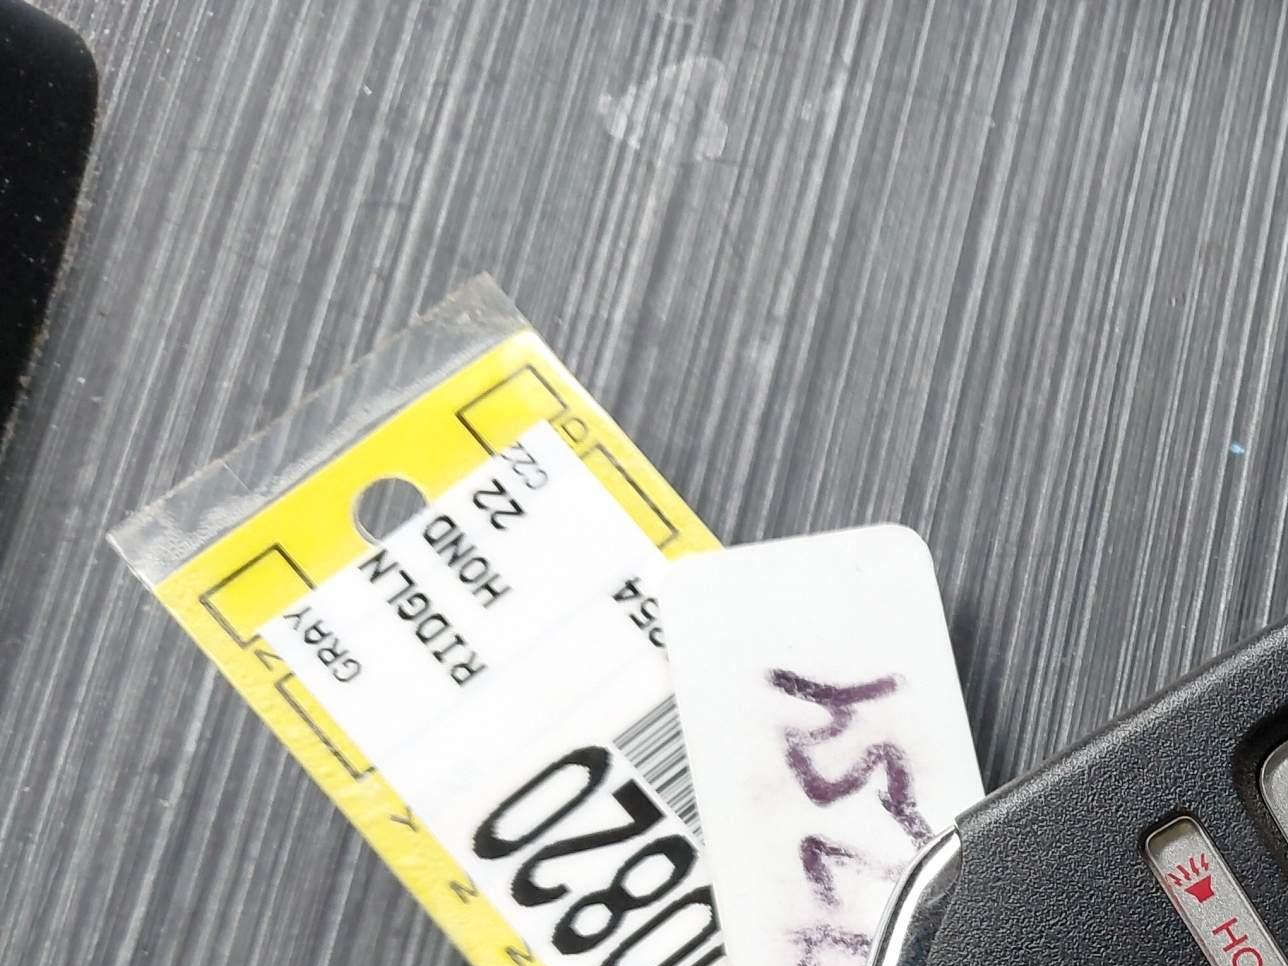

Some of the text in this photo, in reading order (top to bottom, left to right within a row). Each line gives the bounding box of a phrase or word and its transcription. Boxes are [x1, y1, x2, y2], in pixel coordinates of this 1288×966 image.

[471, 477, 527, 531] 22
[422, 514, 512, 609] HOND
[282, 605, 362, 682] GRAY
[358, 547, 488, 687] RIDGLN
